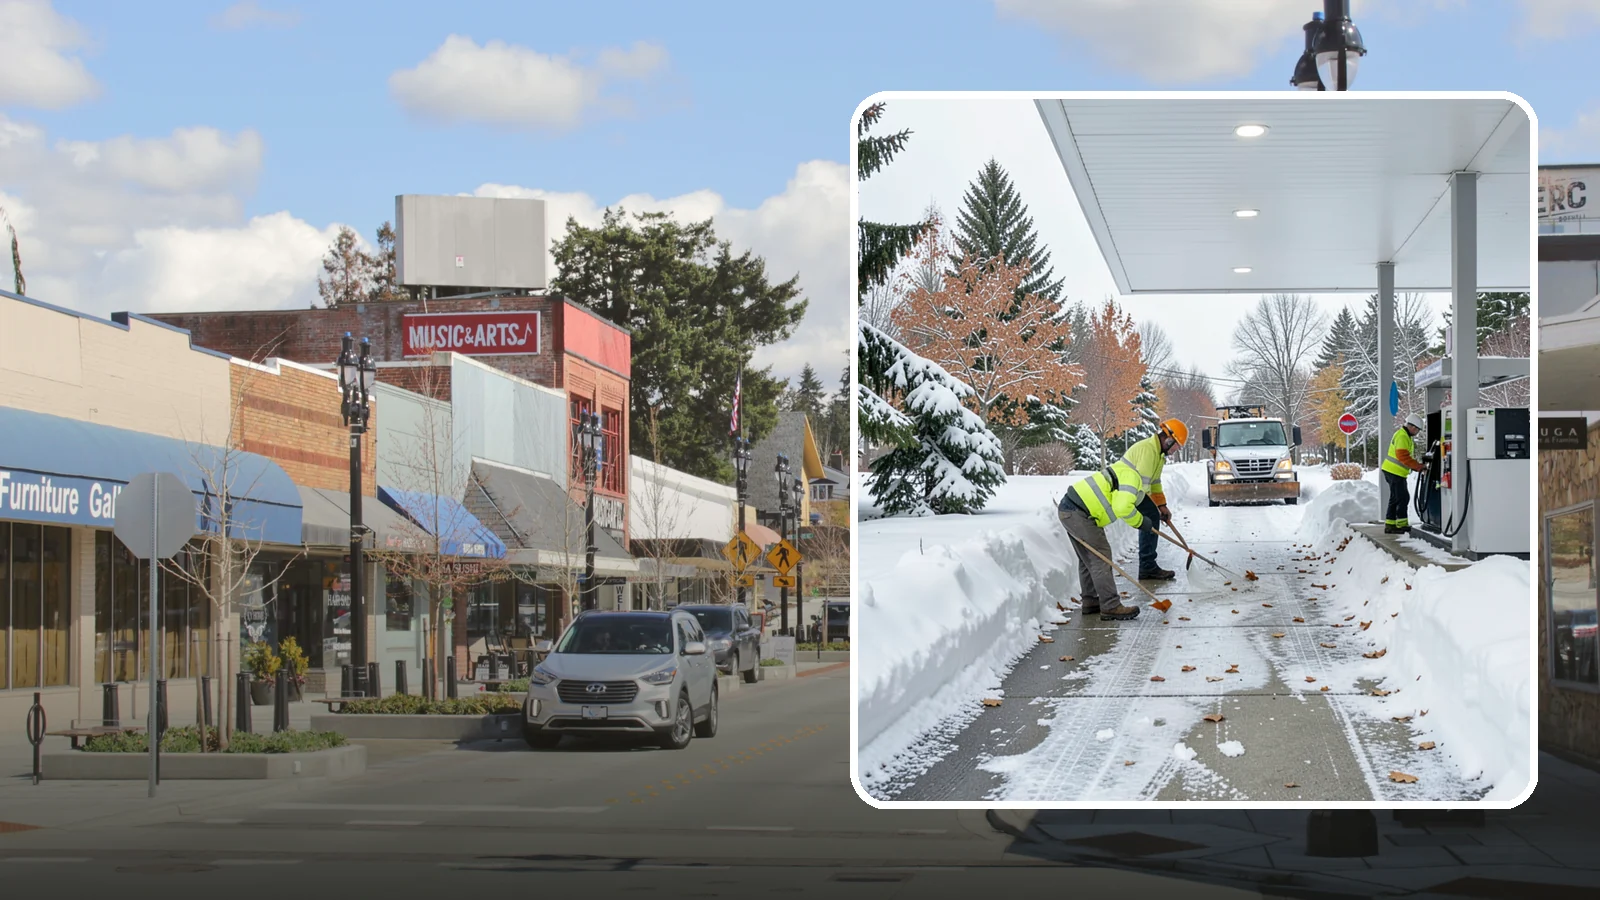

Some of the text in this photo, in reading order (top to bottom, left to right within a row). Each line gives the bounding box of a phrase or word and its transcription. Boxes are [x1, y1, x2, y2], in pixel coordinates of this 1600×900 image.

[1540, 427, 1577, 436] UGA
[0, 471, 122, 518] Furniture Gal
[453, 563, 479, 574] SUSHI
